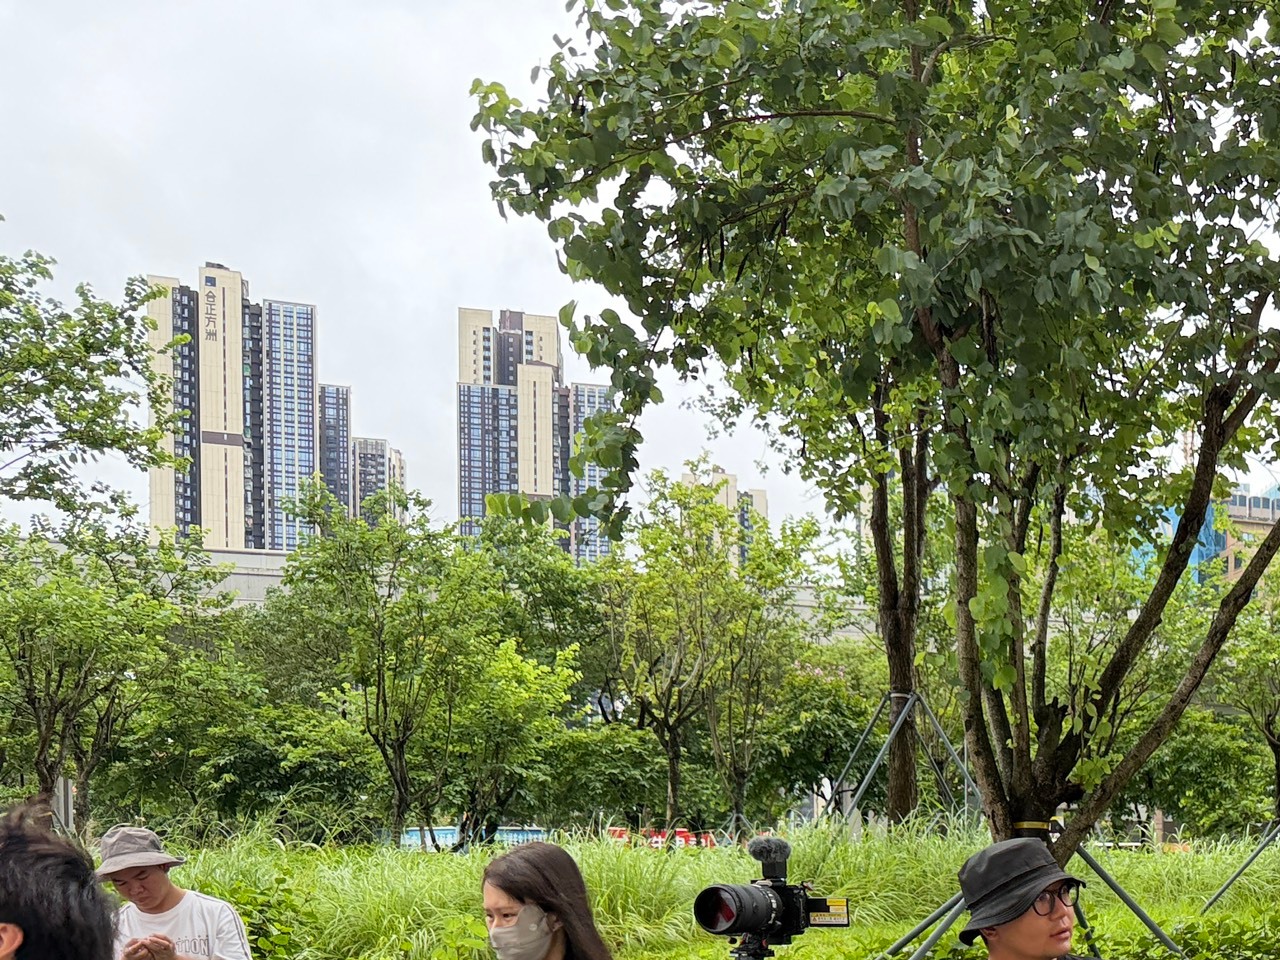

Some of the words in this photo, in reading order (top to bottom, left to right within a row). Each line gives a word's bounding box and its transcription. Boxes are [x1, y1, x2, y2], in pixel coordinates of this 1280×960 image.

[204, 290, 217, 342] 合正方洲
[176, 935, 210, 956] TION
